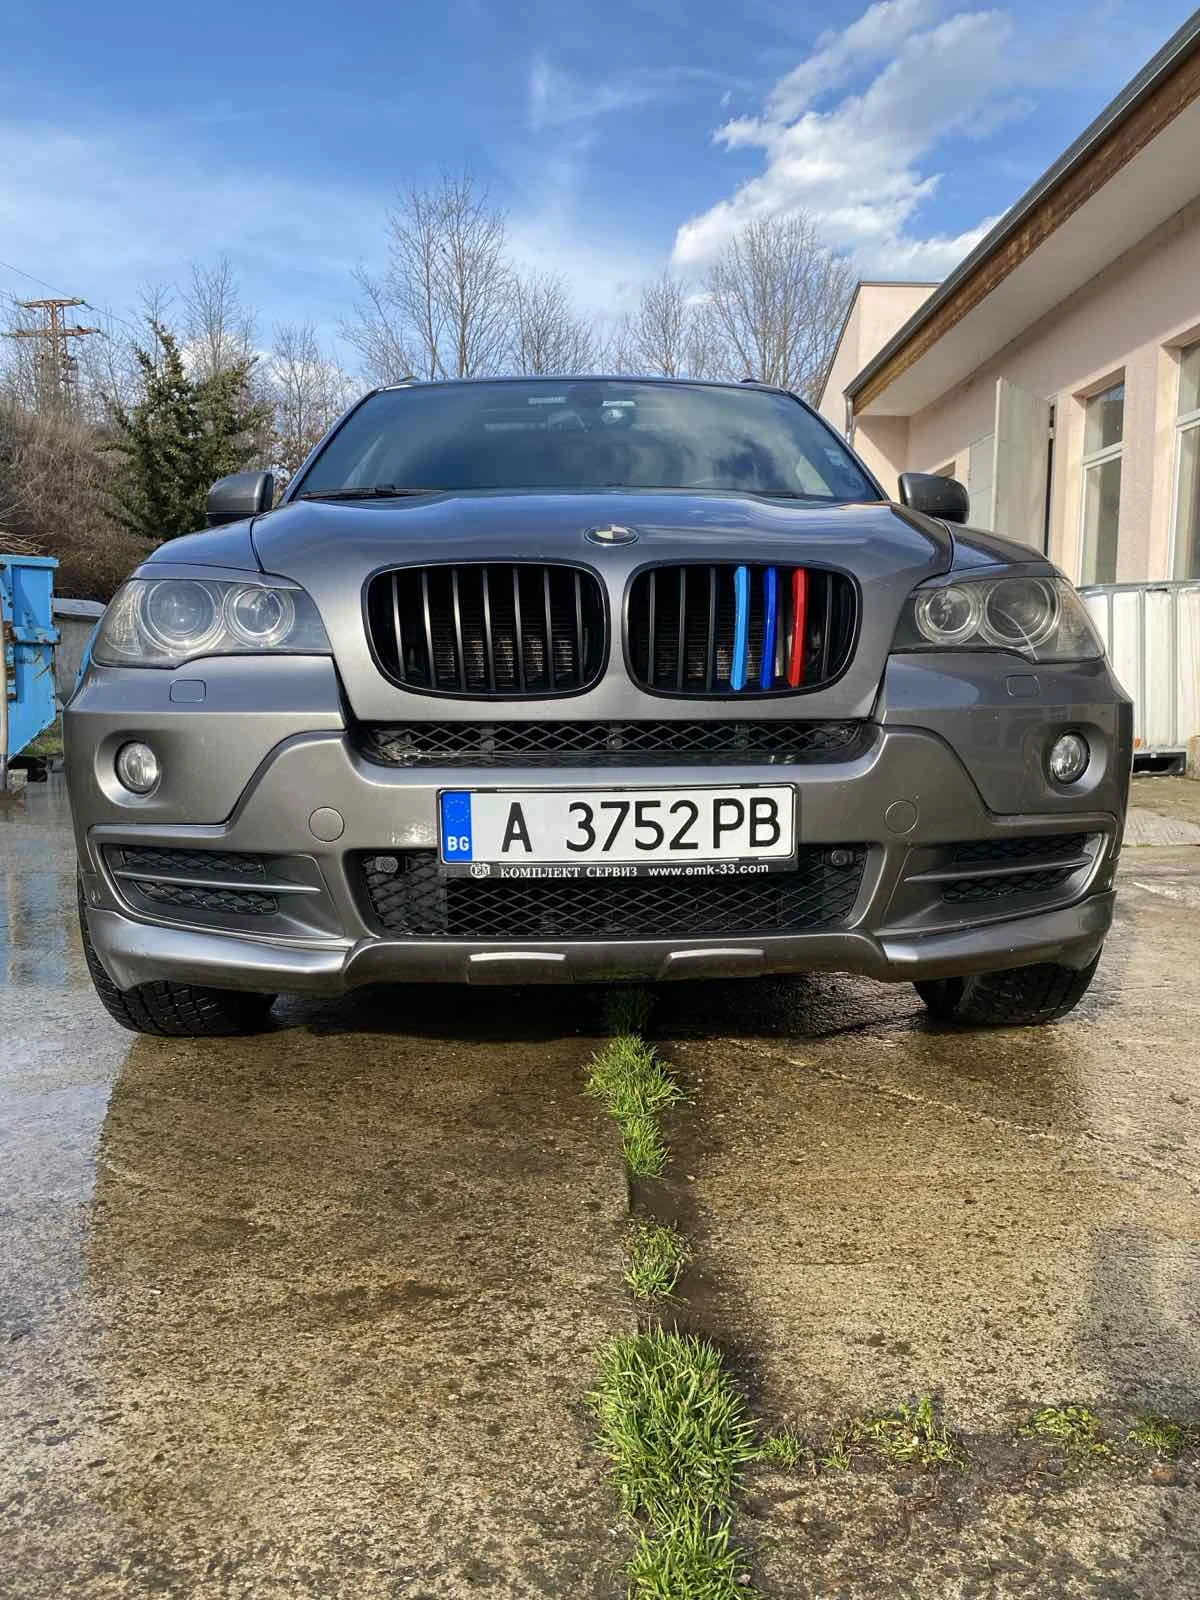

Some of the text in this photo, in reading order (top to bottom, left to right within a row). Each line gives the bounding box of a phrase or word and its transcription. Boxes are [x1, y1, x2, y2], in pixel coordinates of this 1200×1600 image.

[501, 797, 781, 853] A 3752 PB
[446, 836, 470, 851] BG
[500, 866, 638, 878] КОМПЛЕКТ СЕРВИЗ
[648, 863, 769, 877] www.emk-33.com
